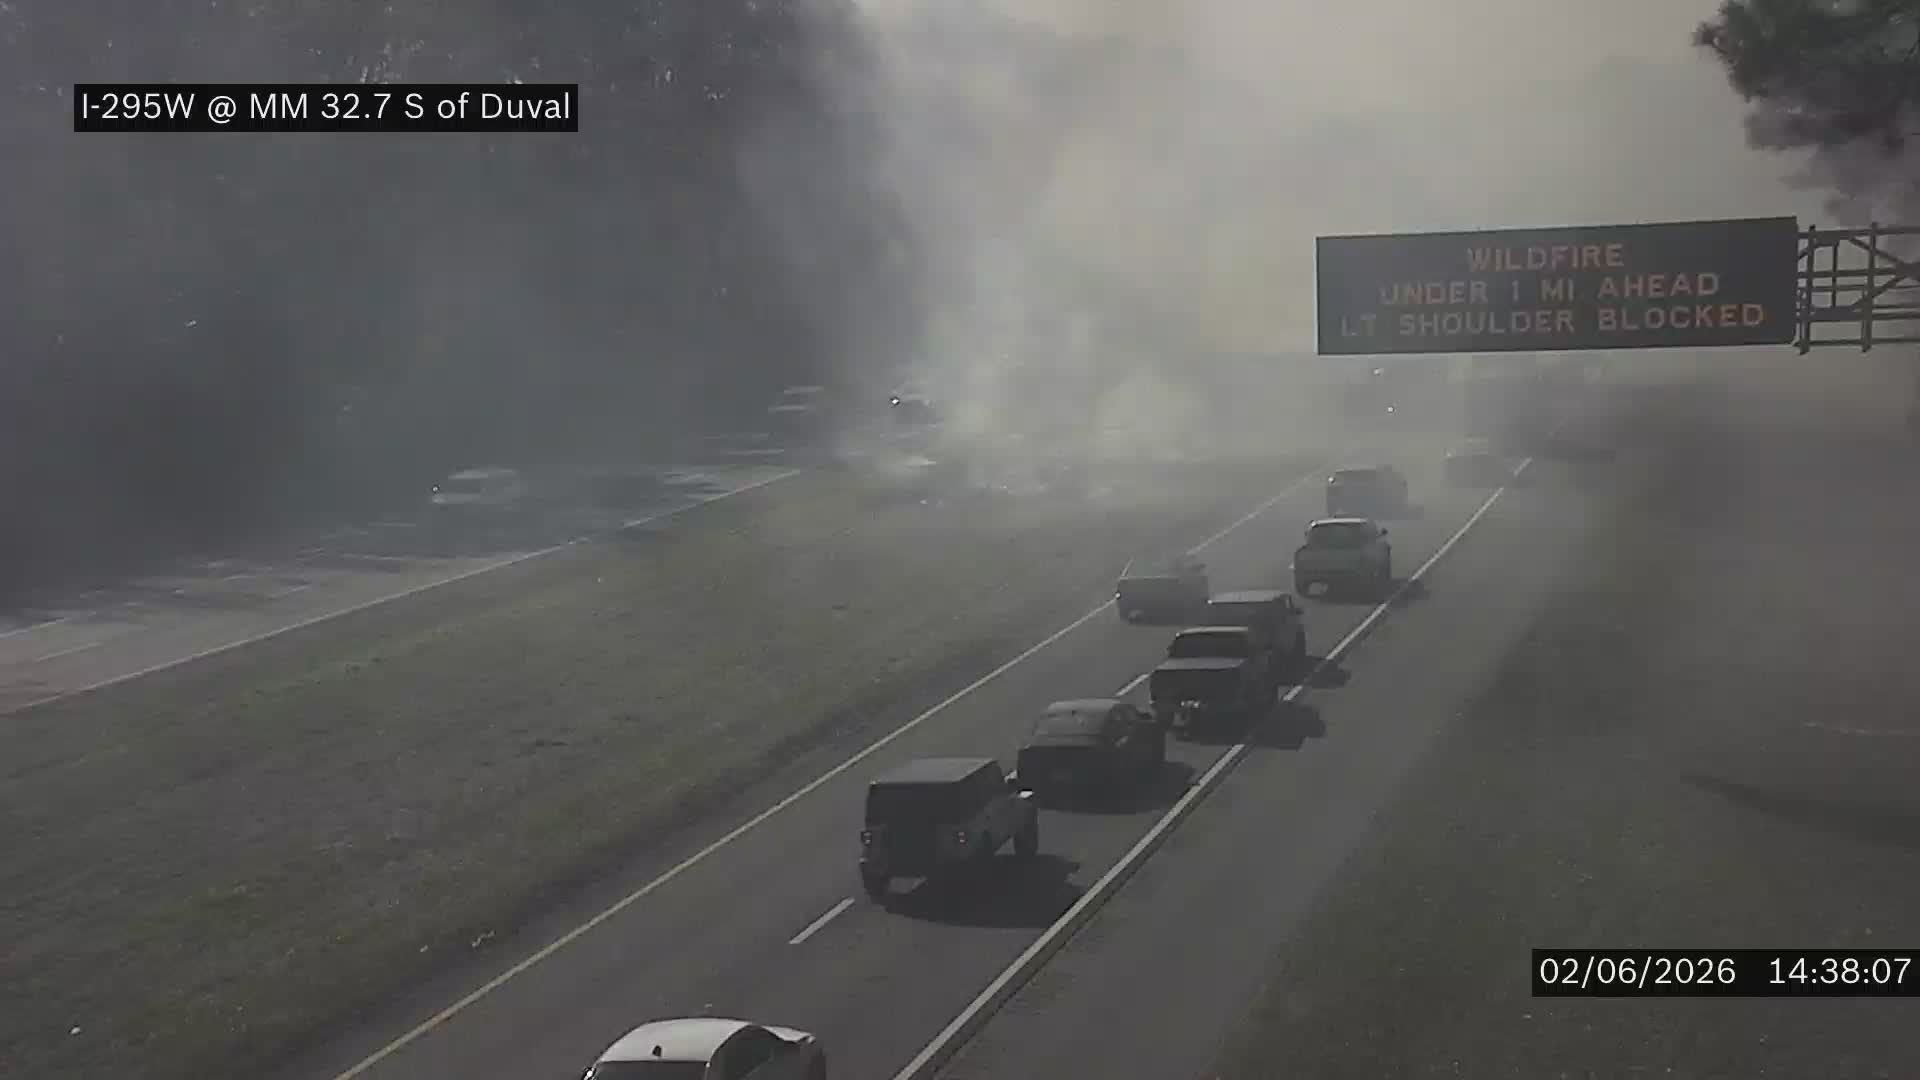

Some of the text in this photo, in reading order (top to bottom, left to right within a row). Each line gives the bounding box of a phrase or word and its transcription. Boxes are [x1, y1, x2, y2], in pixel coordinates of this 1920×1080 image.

[1467, 243, 1625, 271] WILDFIRE
[1381, 272, 1720, 304] UNDER 1 MI AHEAD
[1341, 303, 1764, 337] LT SHOULDER BLOCKED
